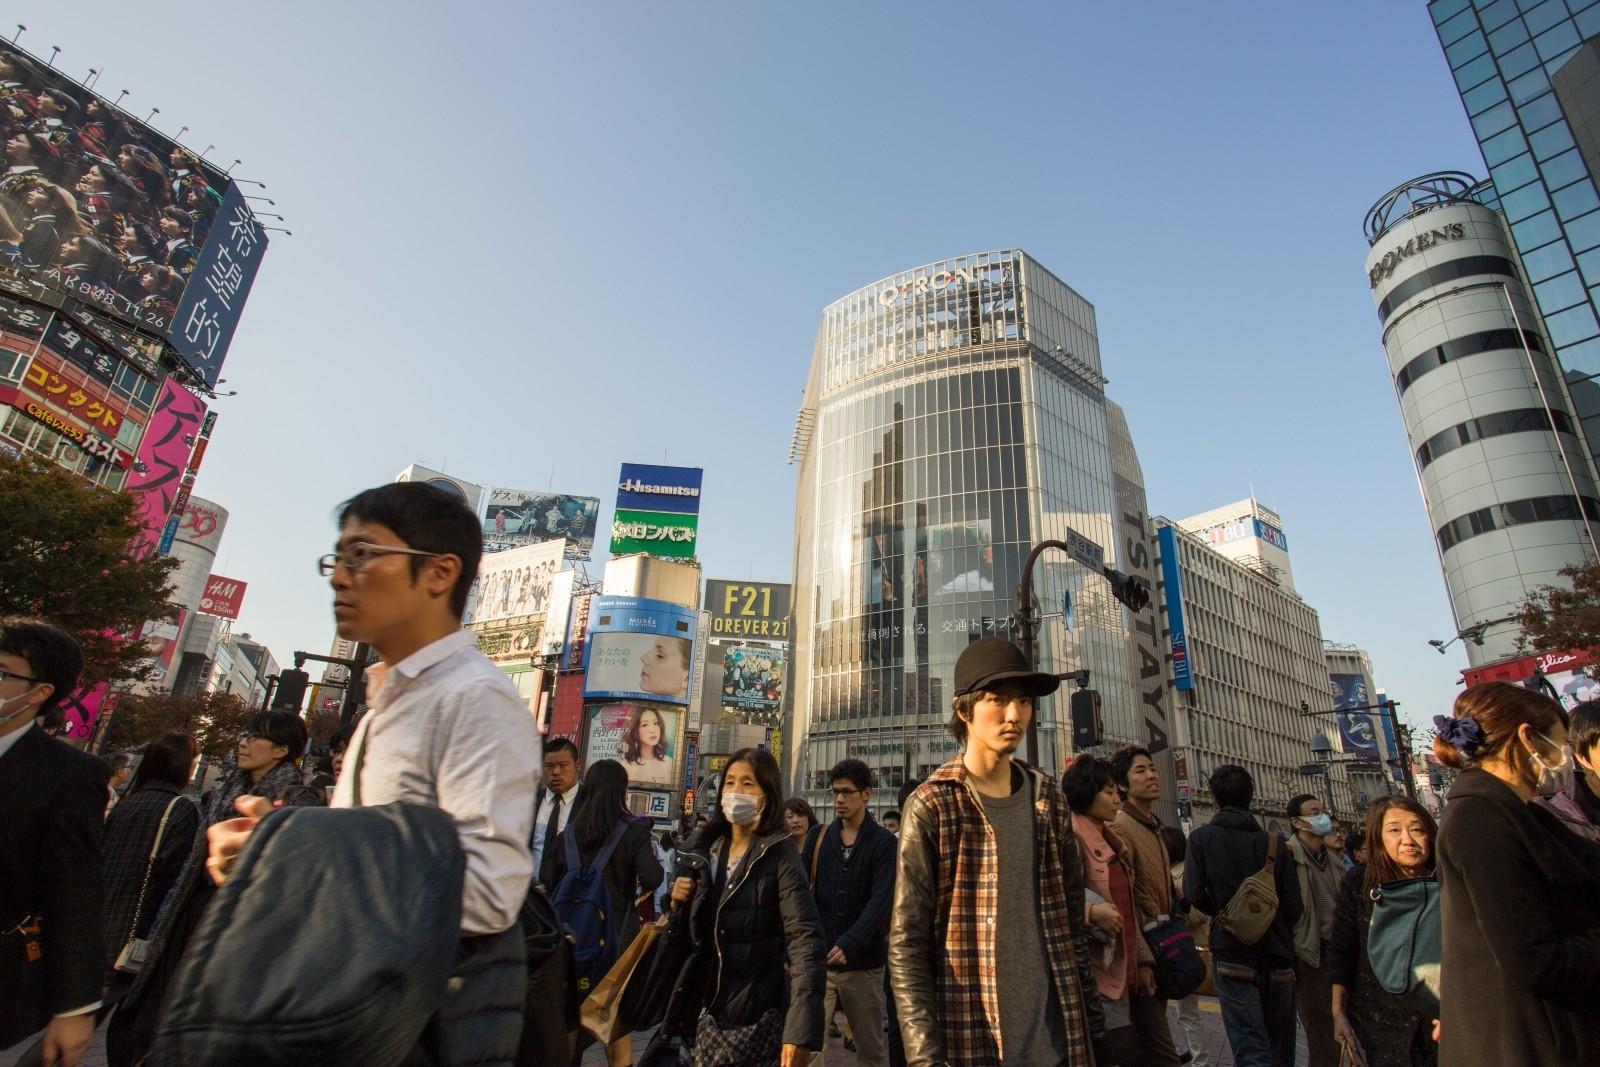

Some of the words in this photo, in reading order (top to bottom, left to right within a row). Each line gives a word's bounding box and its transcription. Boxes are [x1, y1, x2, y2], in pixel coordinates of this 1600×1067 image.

[49, 270, 115, 305] AKB48
[186, 206, 258, 359] 希望的
[26, 362, 118, 428] コンタクト
[81, 432, 124, 464] ガスト
[619, 478, 700, 497] Hisamitsu
[208, 580, 238, 599] H&M
[724, 585, 771, 616] F21
[213, 604, 234, 615] 150m
[711, 618, 769, 635] OREVER
[772, 621, 787, 636] 21
[1171, 632, 1188, 680] SEIBU
[650, 796, 666, 812] 店
